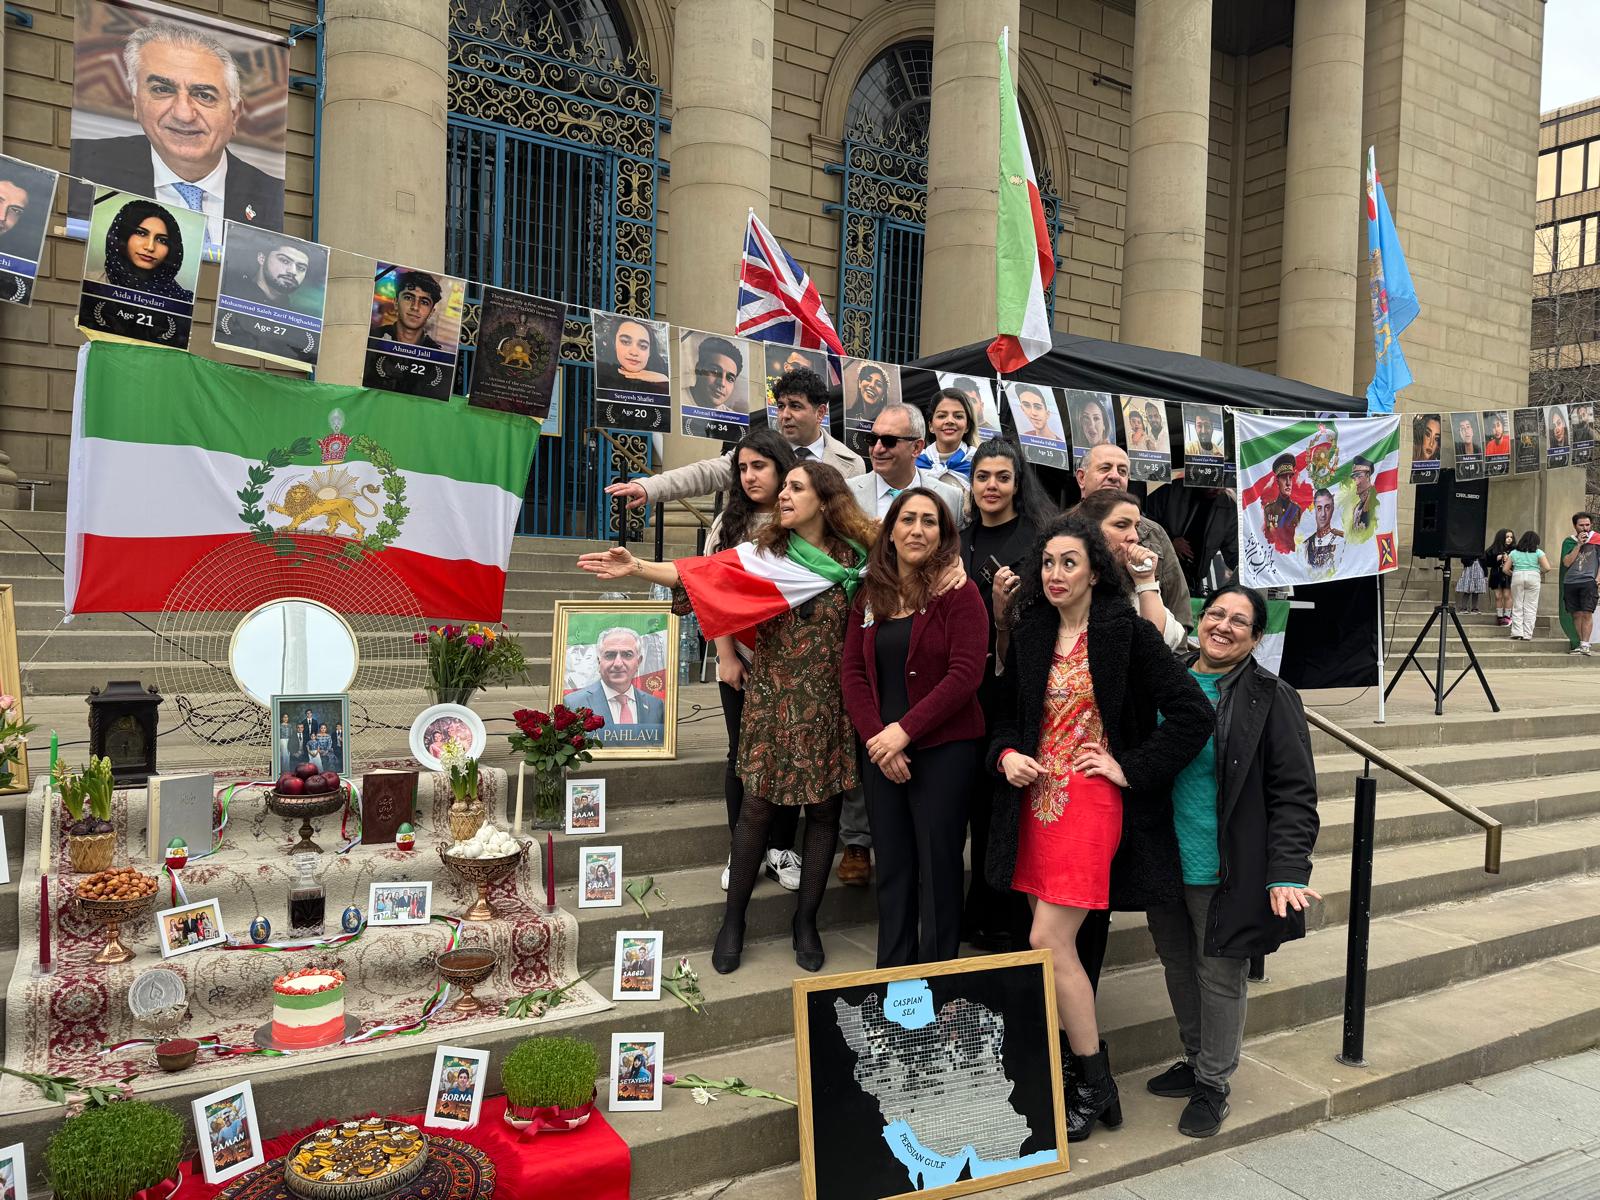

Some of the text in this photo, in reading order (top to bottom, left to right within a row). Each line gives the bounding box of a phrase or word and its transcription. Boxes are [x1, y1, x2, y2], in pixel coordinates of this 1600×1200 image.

[112, 290, 165, 308] Aida Heydari
[221, 299, 256, 312] Mohammad
[257, 308, 271, 316] Saleh
[117, 310, 154, 327] Age 21
[254, 322, 286, 335] Age 27
[392, 345, 416, 354] Ahmad
[395, 362, 425, 375] Age 22
[622, 408, 647, 418] Age 20
[706, 422, 716, 430] Age
[604, 729, 659, 741] PAHLAVI
[573, 810, 594, 818] SAAM
[588, 881, 609, 890] SARA
[893, 996, 923, 1007] CASPIAN
[902, 1008, 915, 1016] SEA
[442, 1093, 472, 1101] BORNA
[213, 1132, 245, 1154] SAMAN
[900, 1133, 946, 1168] PERSIAN GULF
